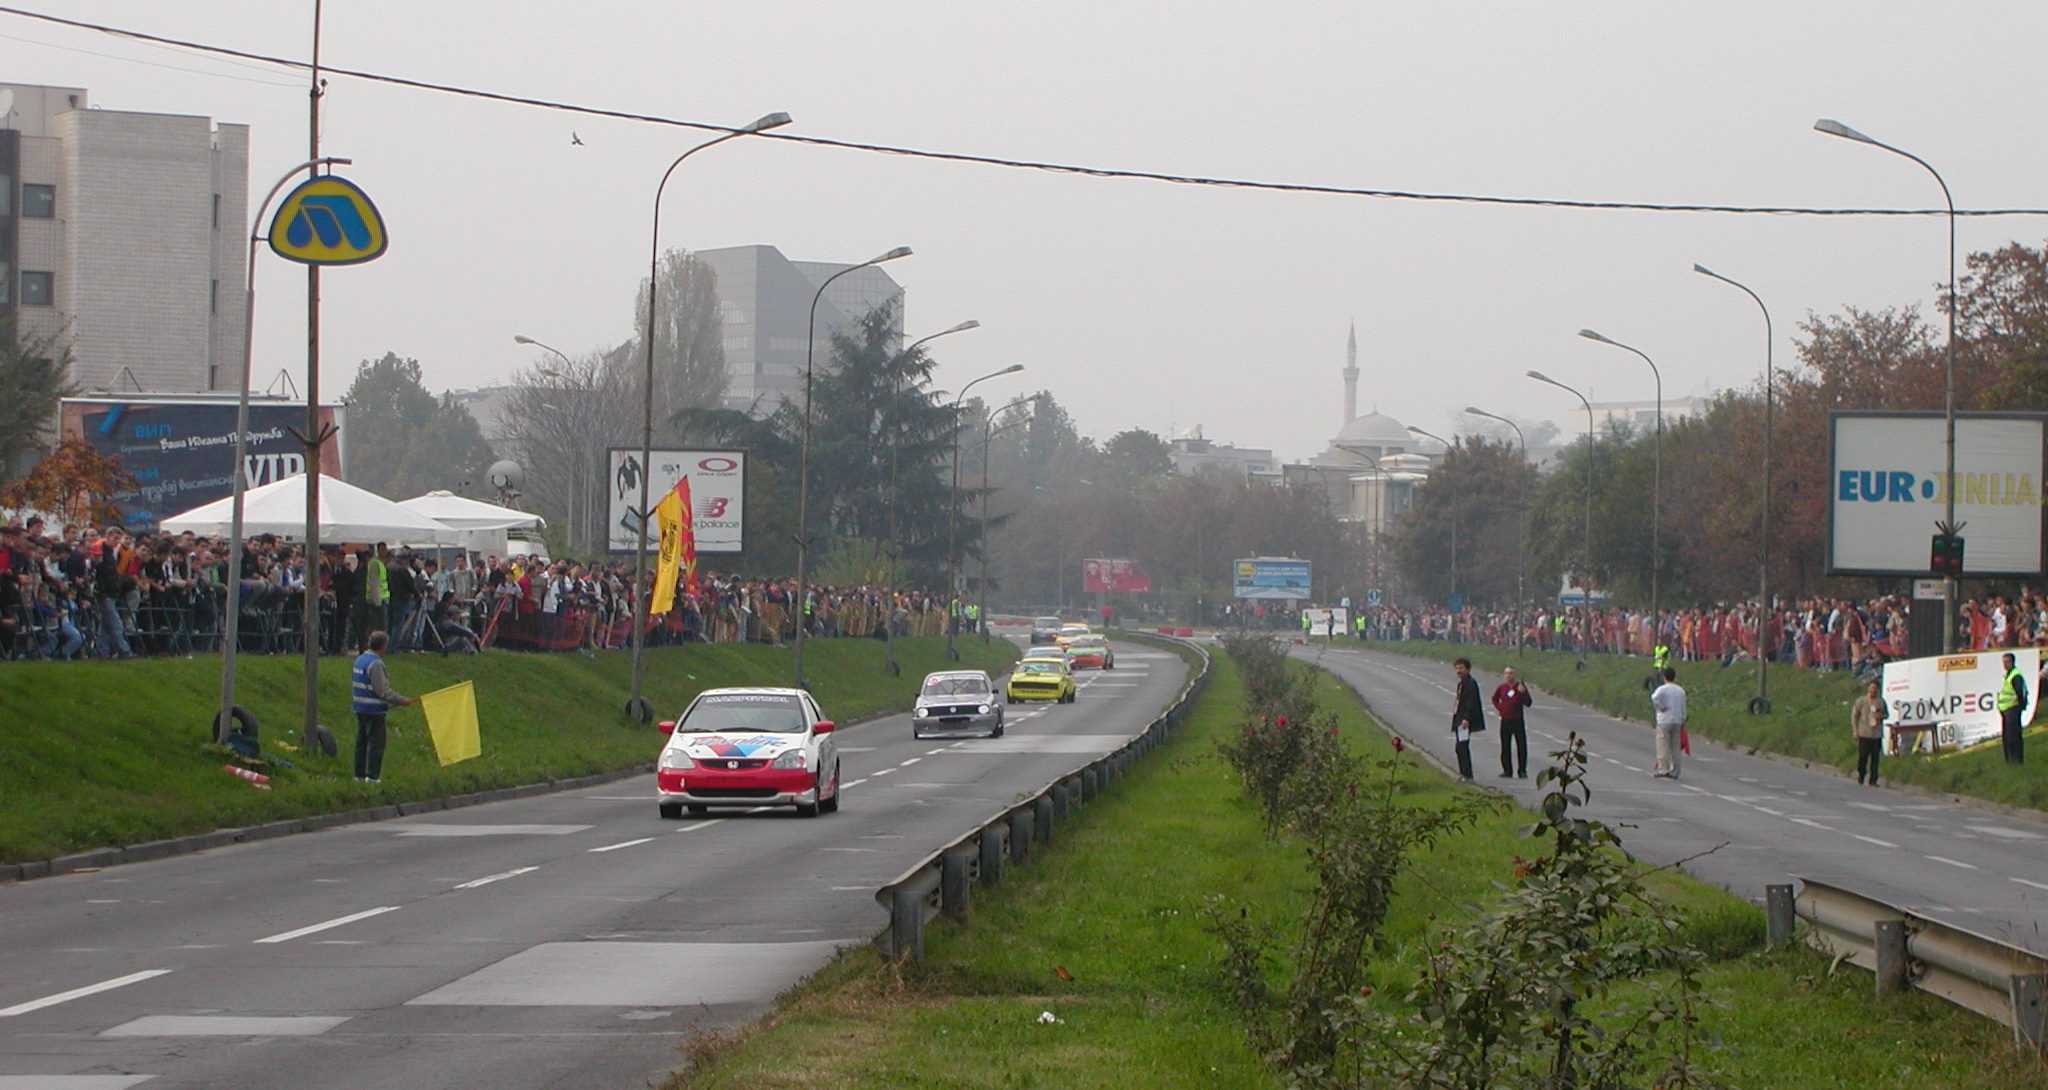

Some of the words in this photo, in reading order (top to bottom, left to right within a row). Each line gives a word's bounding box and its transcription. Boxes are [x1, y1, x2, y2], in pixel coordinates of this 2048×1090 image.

[227, 427, 282, 446] Пдружба
[244, 452, 305, 490] VIP
[700, 519, 740, 529] balance
